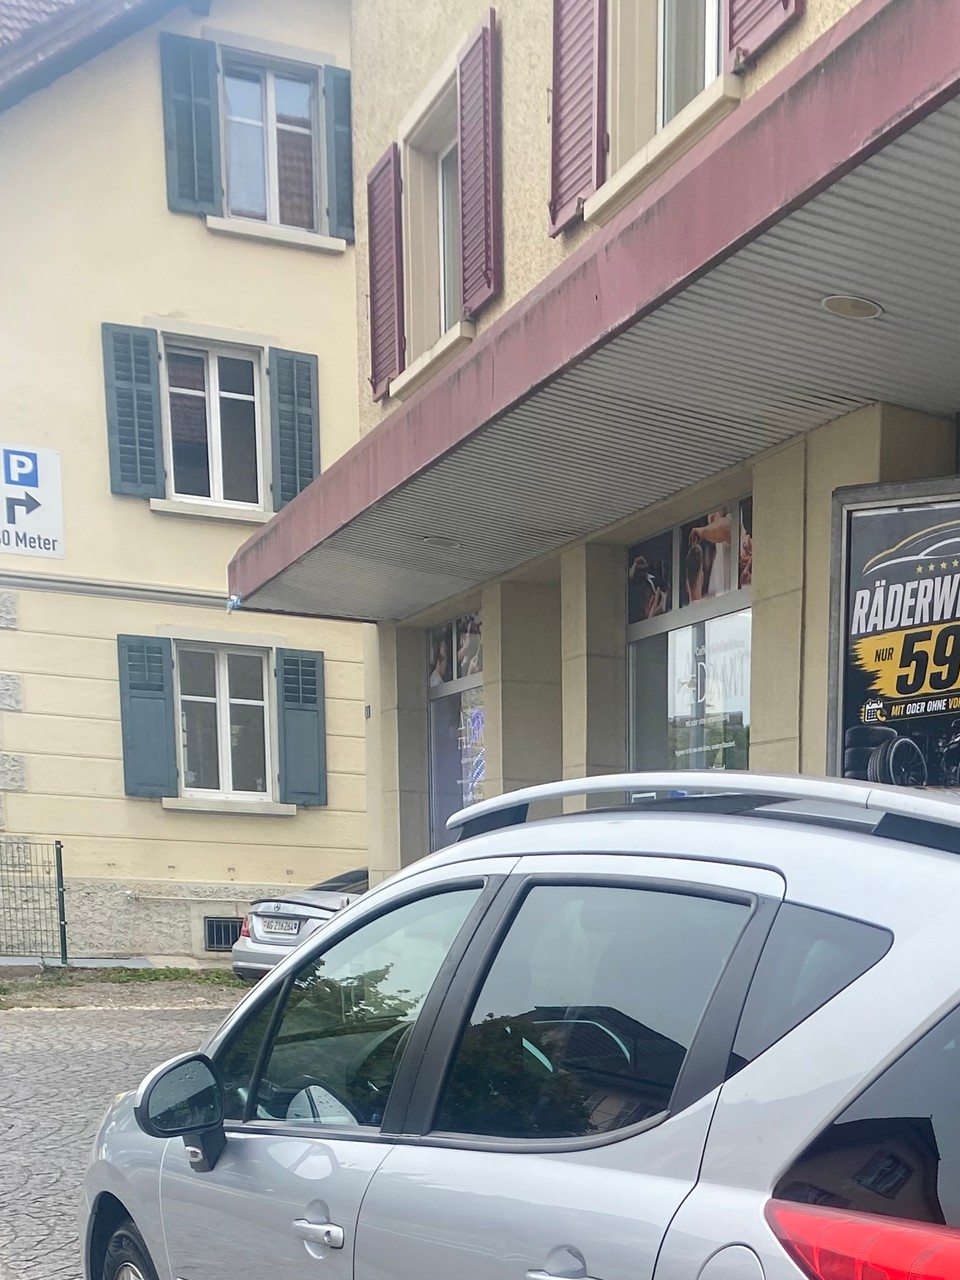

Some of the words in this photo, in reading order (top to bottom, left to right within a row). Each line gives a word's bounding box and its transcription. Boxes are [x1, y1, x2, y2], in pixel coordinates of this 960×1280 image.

[8, 453, 34, 482] P
[15, 530, 58, 551] Meter
[874, 647, 894, 662] NUR
[891, 703, 905, 717] MIT
[906, 701, 925, 715] ODER
[927, 698, 947, 712] OHNE
